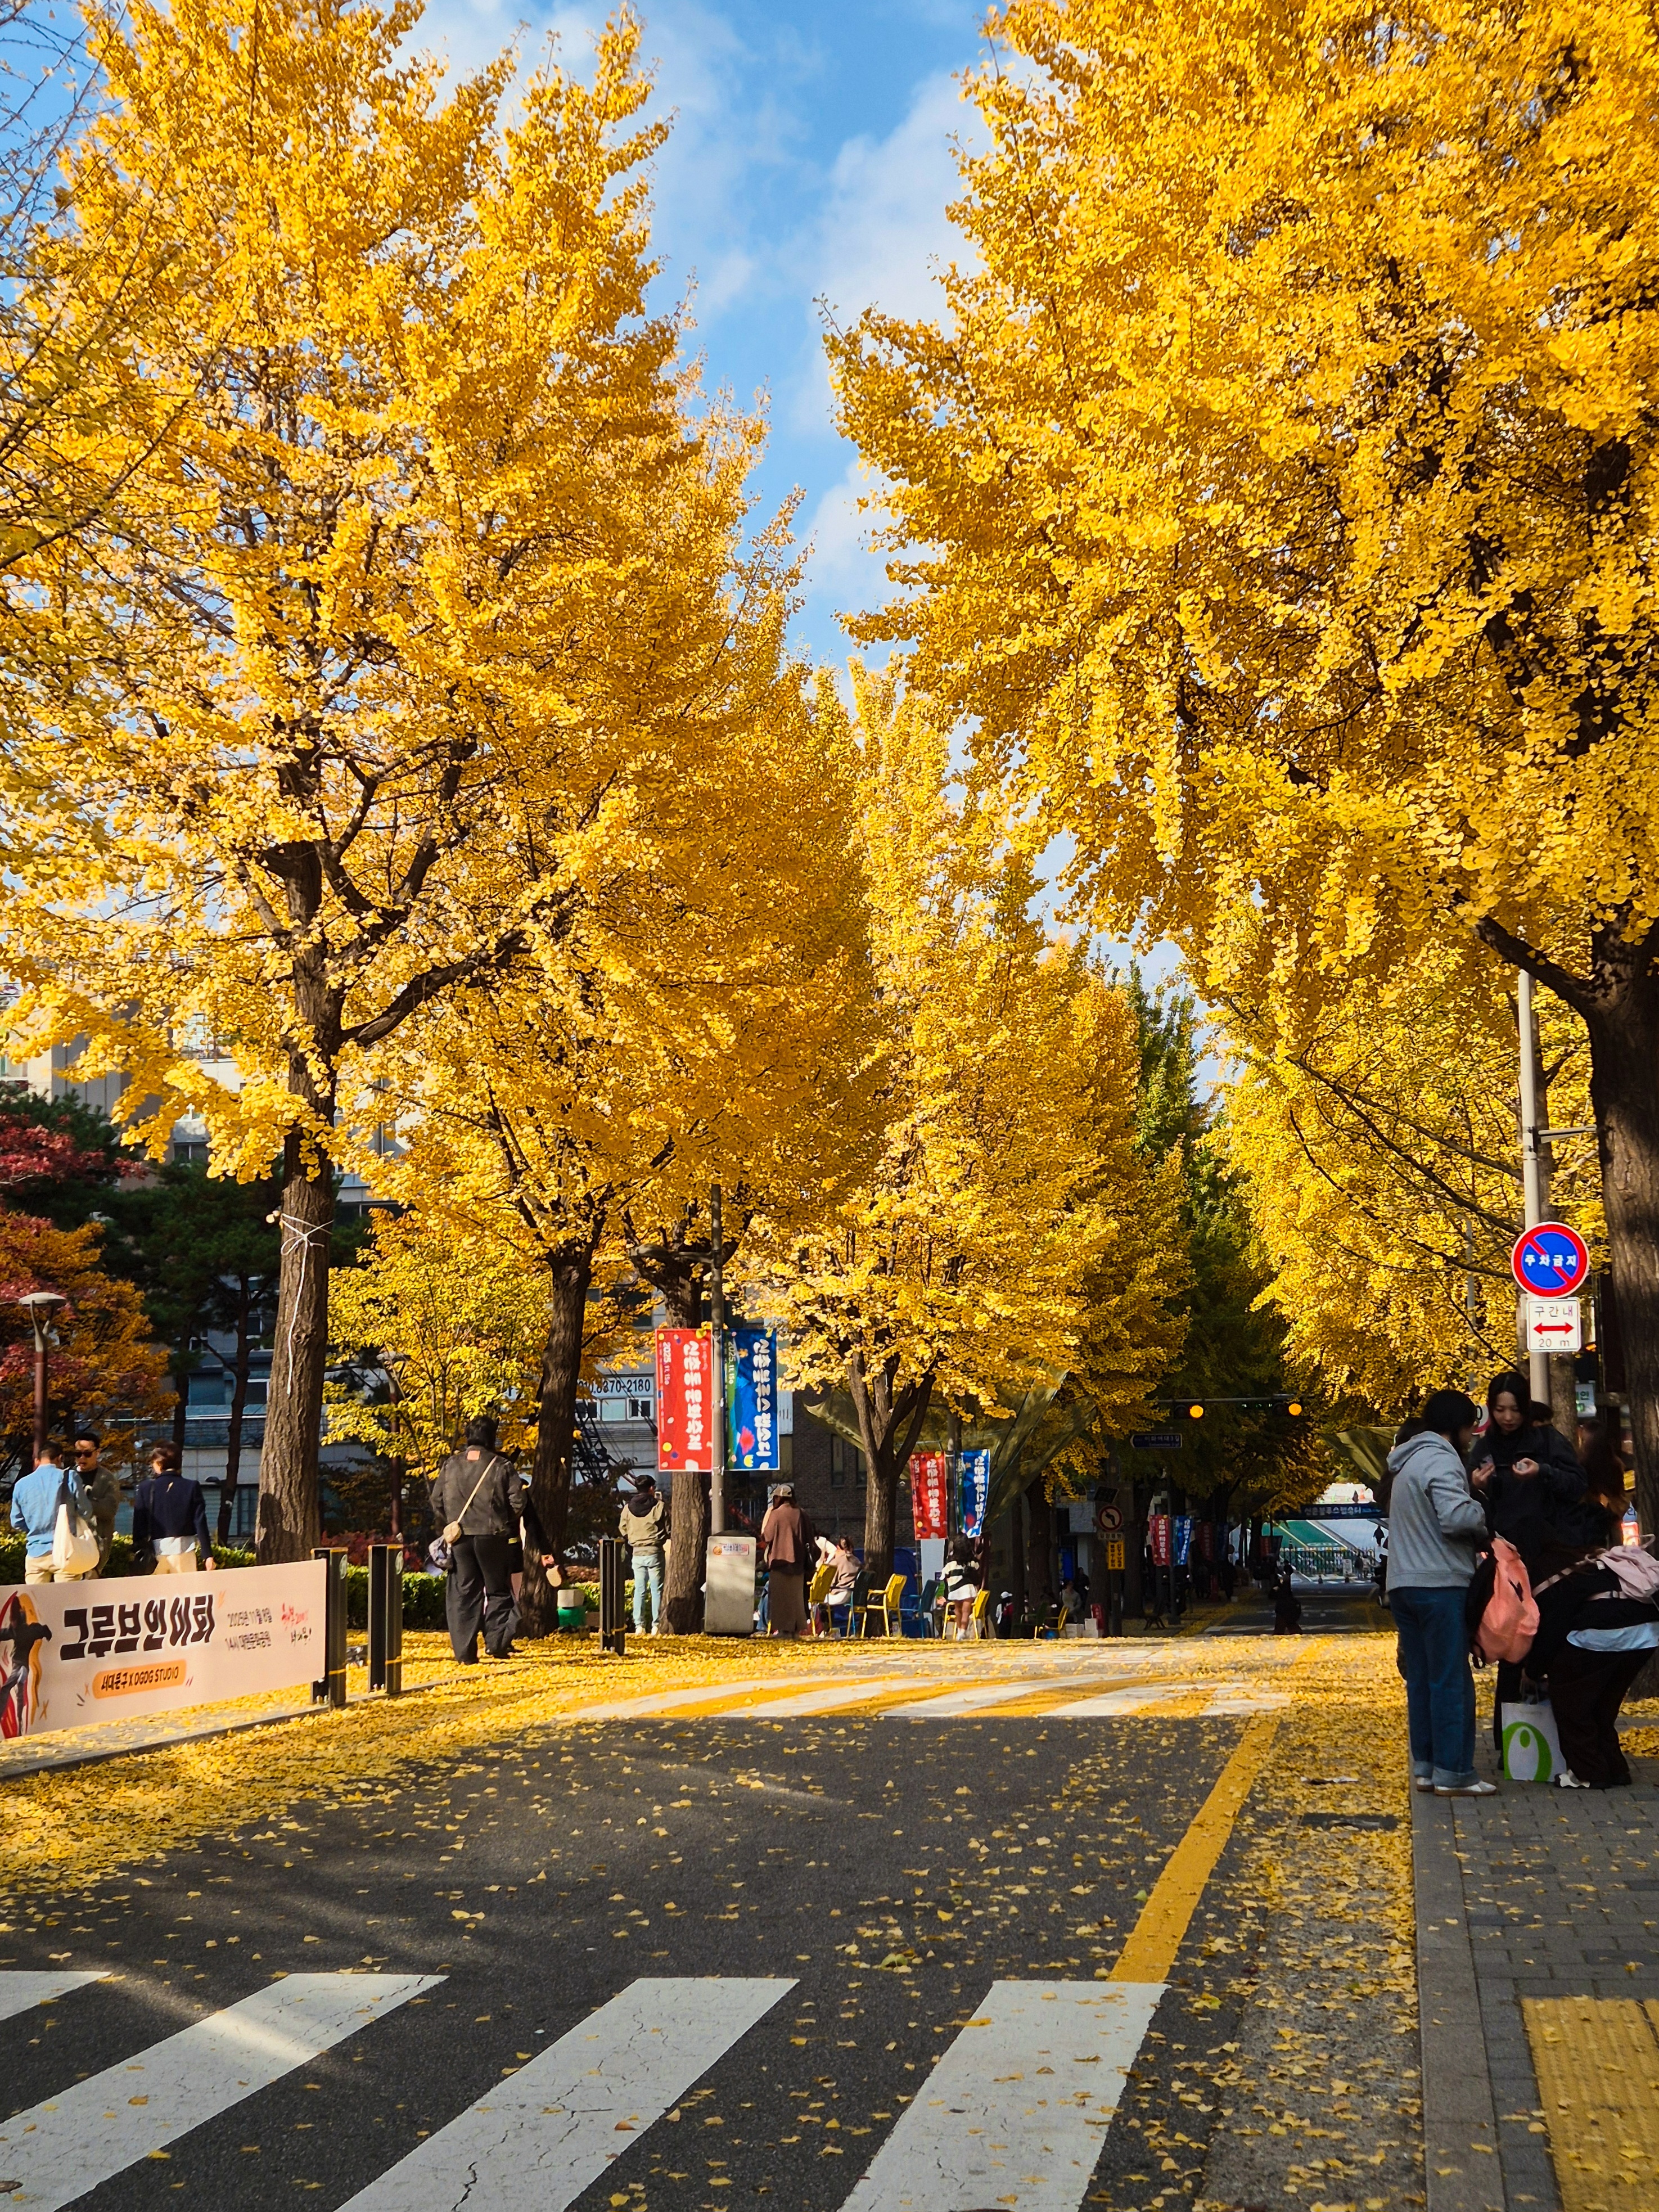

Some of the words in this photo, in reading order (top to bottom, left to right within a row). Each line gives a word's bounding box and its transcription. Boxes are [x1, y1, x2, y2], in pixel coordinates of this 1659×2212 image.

[1525, 1254, 1576, 1267] 주차금지
[1535, 1305, 1559, 1318] 구간
[1563, 1305, 1573, 1317] 내
[1539, 1338, 1552, 1348] 20
[685, 1388, 704, 1451] 문화축제
[101, 1672, 128, 1691] 서대문구
[155, 1666, 179, 1682] STUDIO
